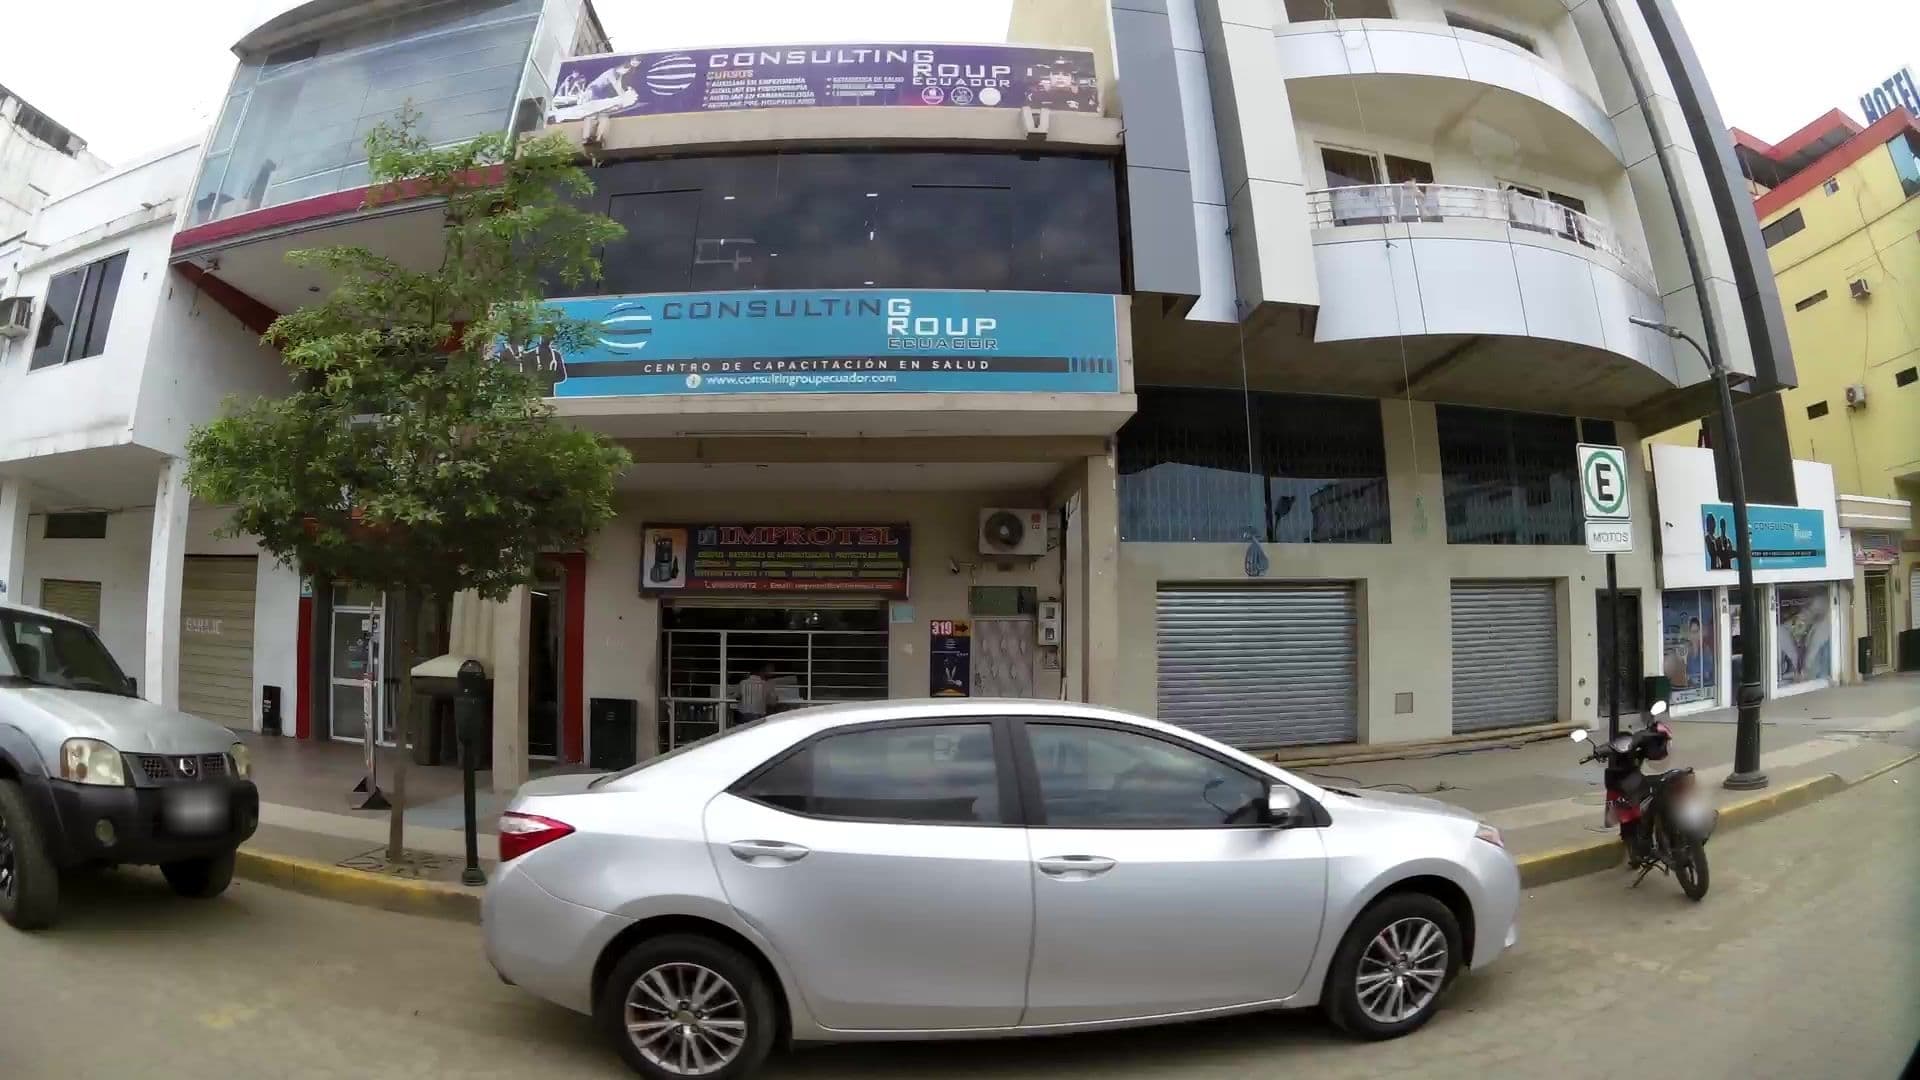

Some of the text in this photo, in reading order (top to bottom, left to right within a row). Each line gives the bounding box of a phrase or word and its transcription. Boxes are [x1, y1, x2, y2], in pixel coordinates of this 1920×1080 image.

[912, 77, 1011, 88] ECUADOR
[887, 338, 999, 350] ECUADOR
[643, 358, 989, 373] CENTRO DE CAPACITACIÓN EN SALUD
[1595, 463, 1614, 501] E
[719, 527, 899, 545] IMPROTEL
[1593, 532, 1629, 543] MOTOS
[932, 621, 952, 635] 319
